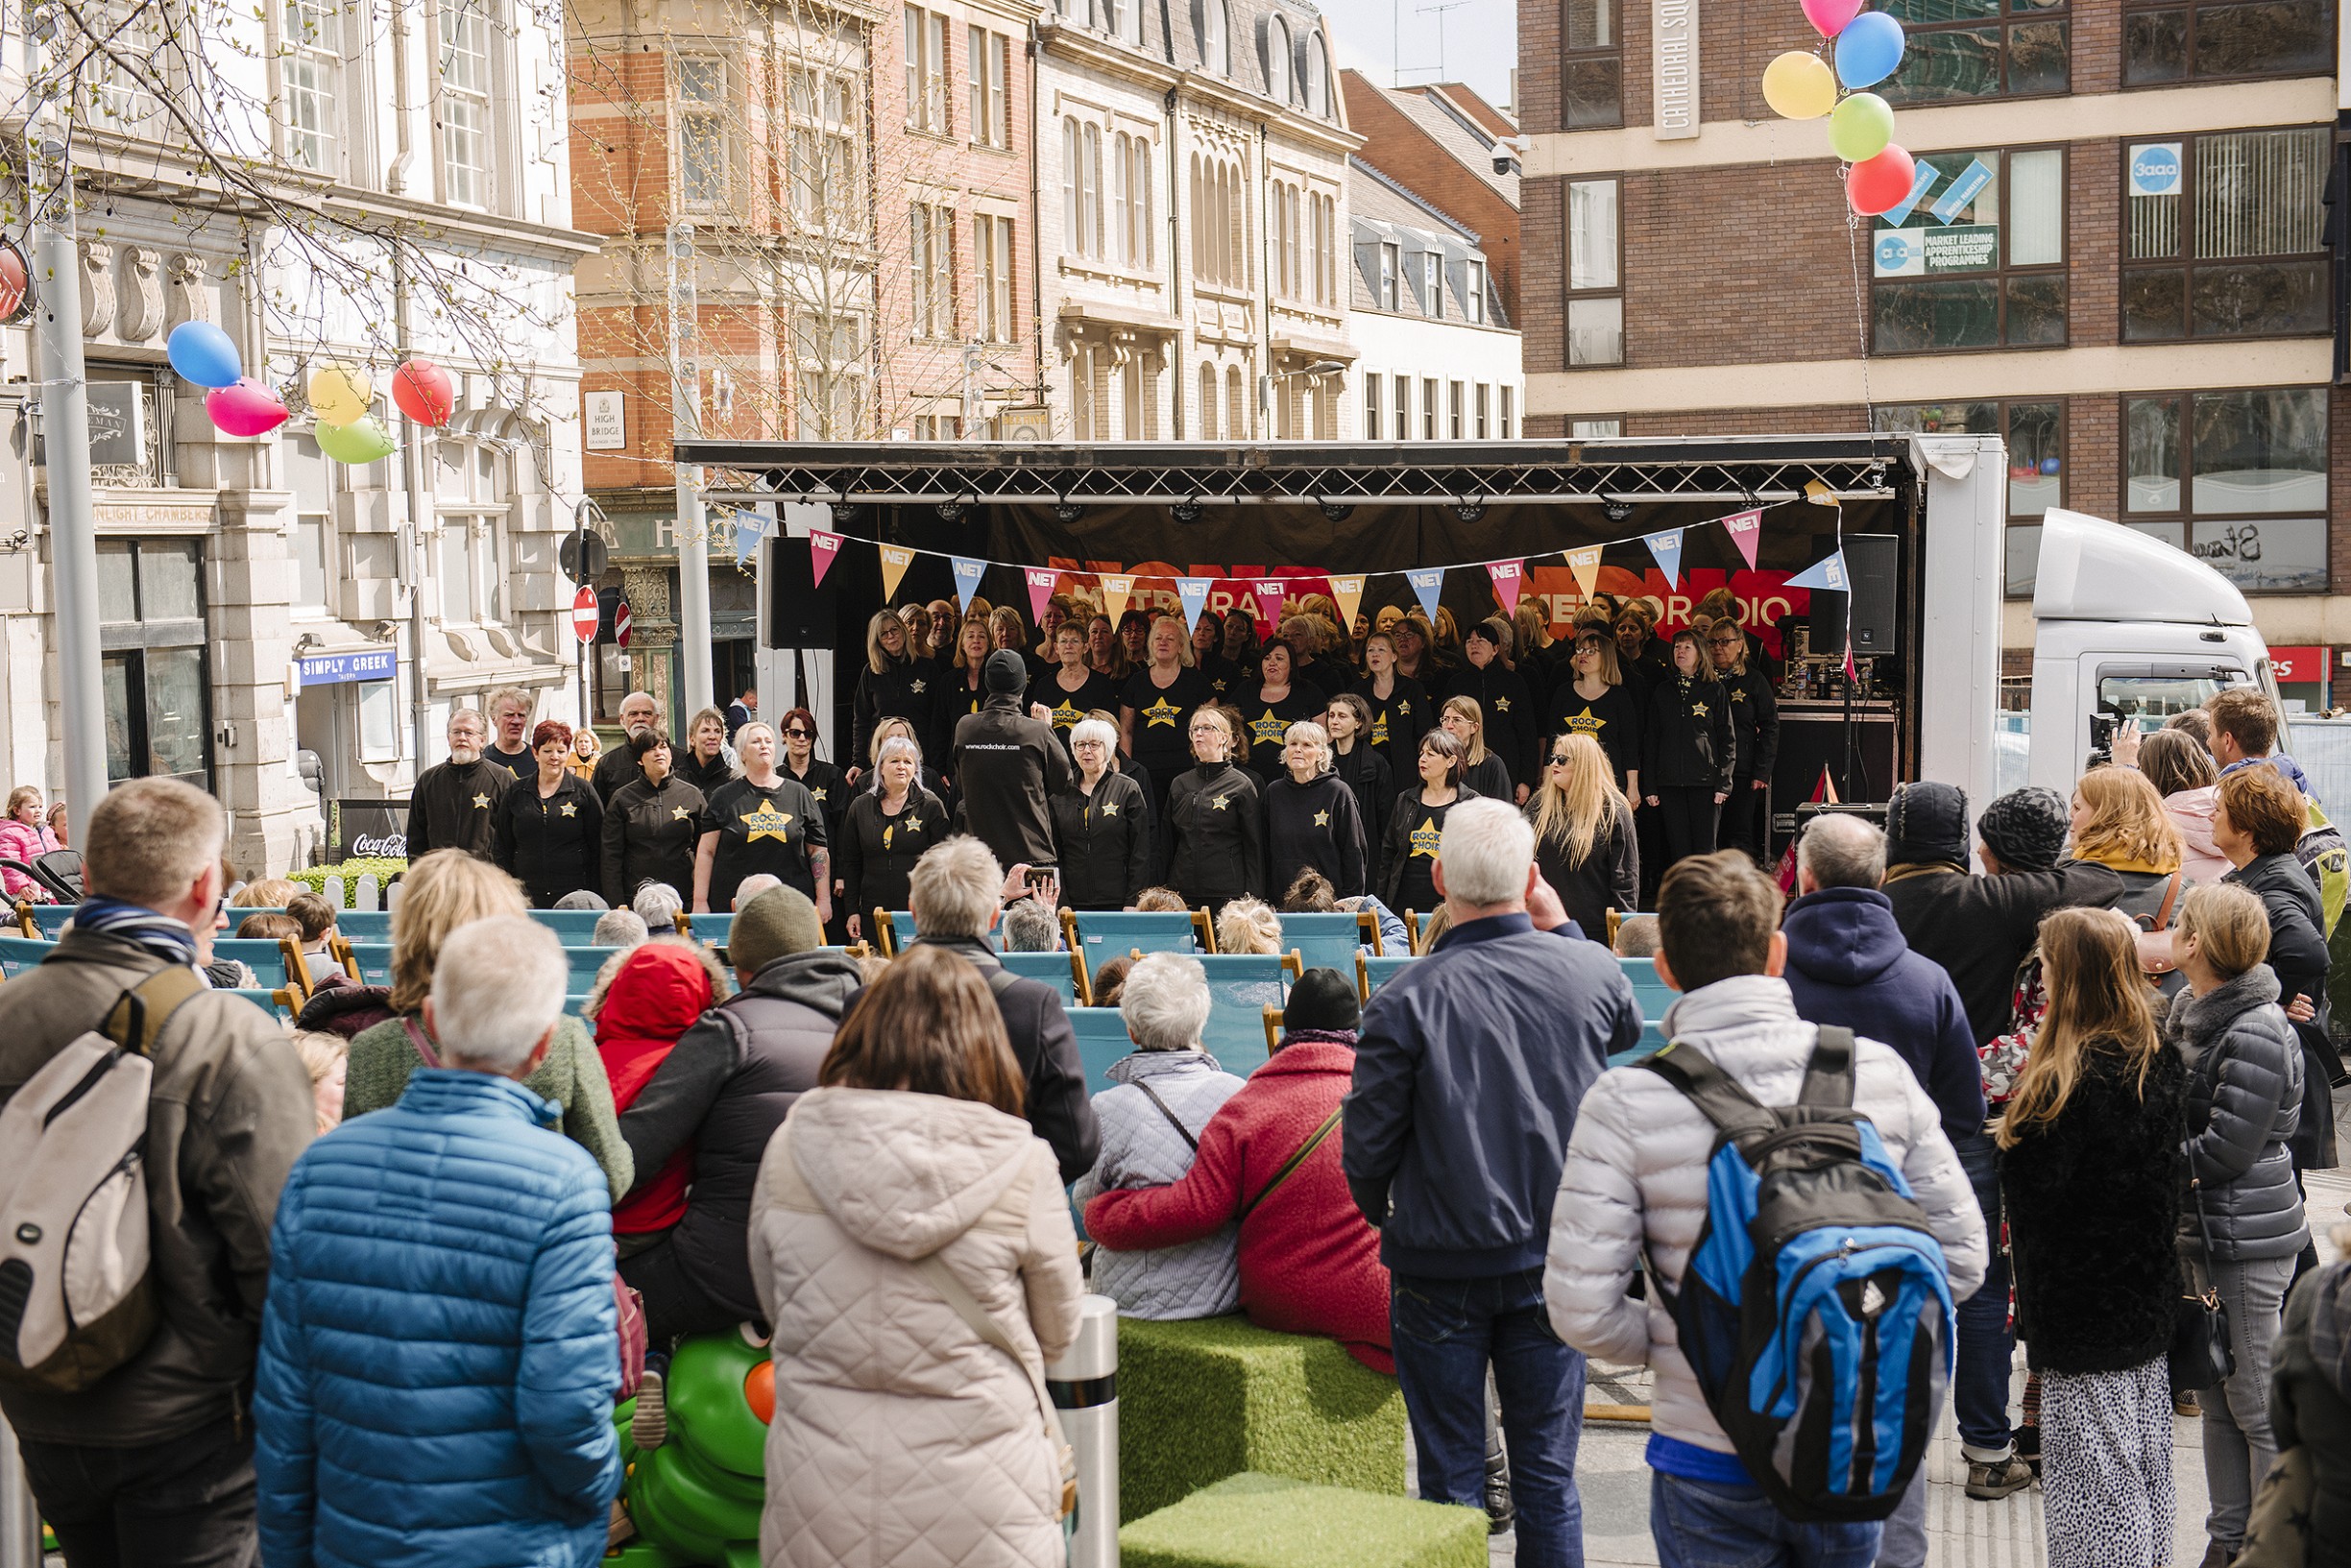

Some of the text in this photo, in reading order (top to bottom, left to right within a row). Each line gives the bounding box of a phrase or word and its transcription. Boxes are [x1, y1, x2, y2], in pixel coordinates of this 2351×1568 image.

[1660, 32, 1689, 129] CATHEDRAL
[2135, 162, 2177, 177] 3aaa
[1925, 233, 1994, 247] MARKET LEADING
[1925, 244, 1994, 257] APPRENTICESHIP
[1928, 254, 1989, 267] PROGRAMMES
[88, 418, 122, 428] EMAN
[594, 415, 616, 423] HIGH
[592, 426, 620, 436] BRIDGE
[93, 507, 209, 521] NLIGHT CHAMBERS
[739, 515, 766, 534] NE1
[1729, 514, 1758, 534] NE1
[812, 533, 838, 552] NE1
[1650, 534, 1681, 553] NE1
[883, 549, 909, 566] NE1
[1569, 550, 1599, 567] NE1
[956, 562, 982, 578] NE1
[1491, 563, 1521, 580] NE1
[1028, 571, 1055, 588] NE1
[1103, 578, 1130, 593] NE1
[1334, 579, 1362, 593] NE1
[1413, 572, 1441, 589] NE1
[1180, 582, 1207, 596] NE1
[1256, 583, 1285, 595] NE1
[303, 655, 389, 676] SIMPLY GREEK
[1052, 710, 1076, 718] ROCK
[1571, 718, 1597, 727] ROCK
[750, 813, 784, 824] ROCK
[749, 823, 787, 832] CHOIR
[1413, 832, 1441, 842] ROCK
[1412, 841, 1441, 851] CHOIR
